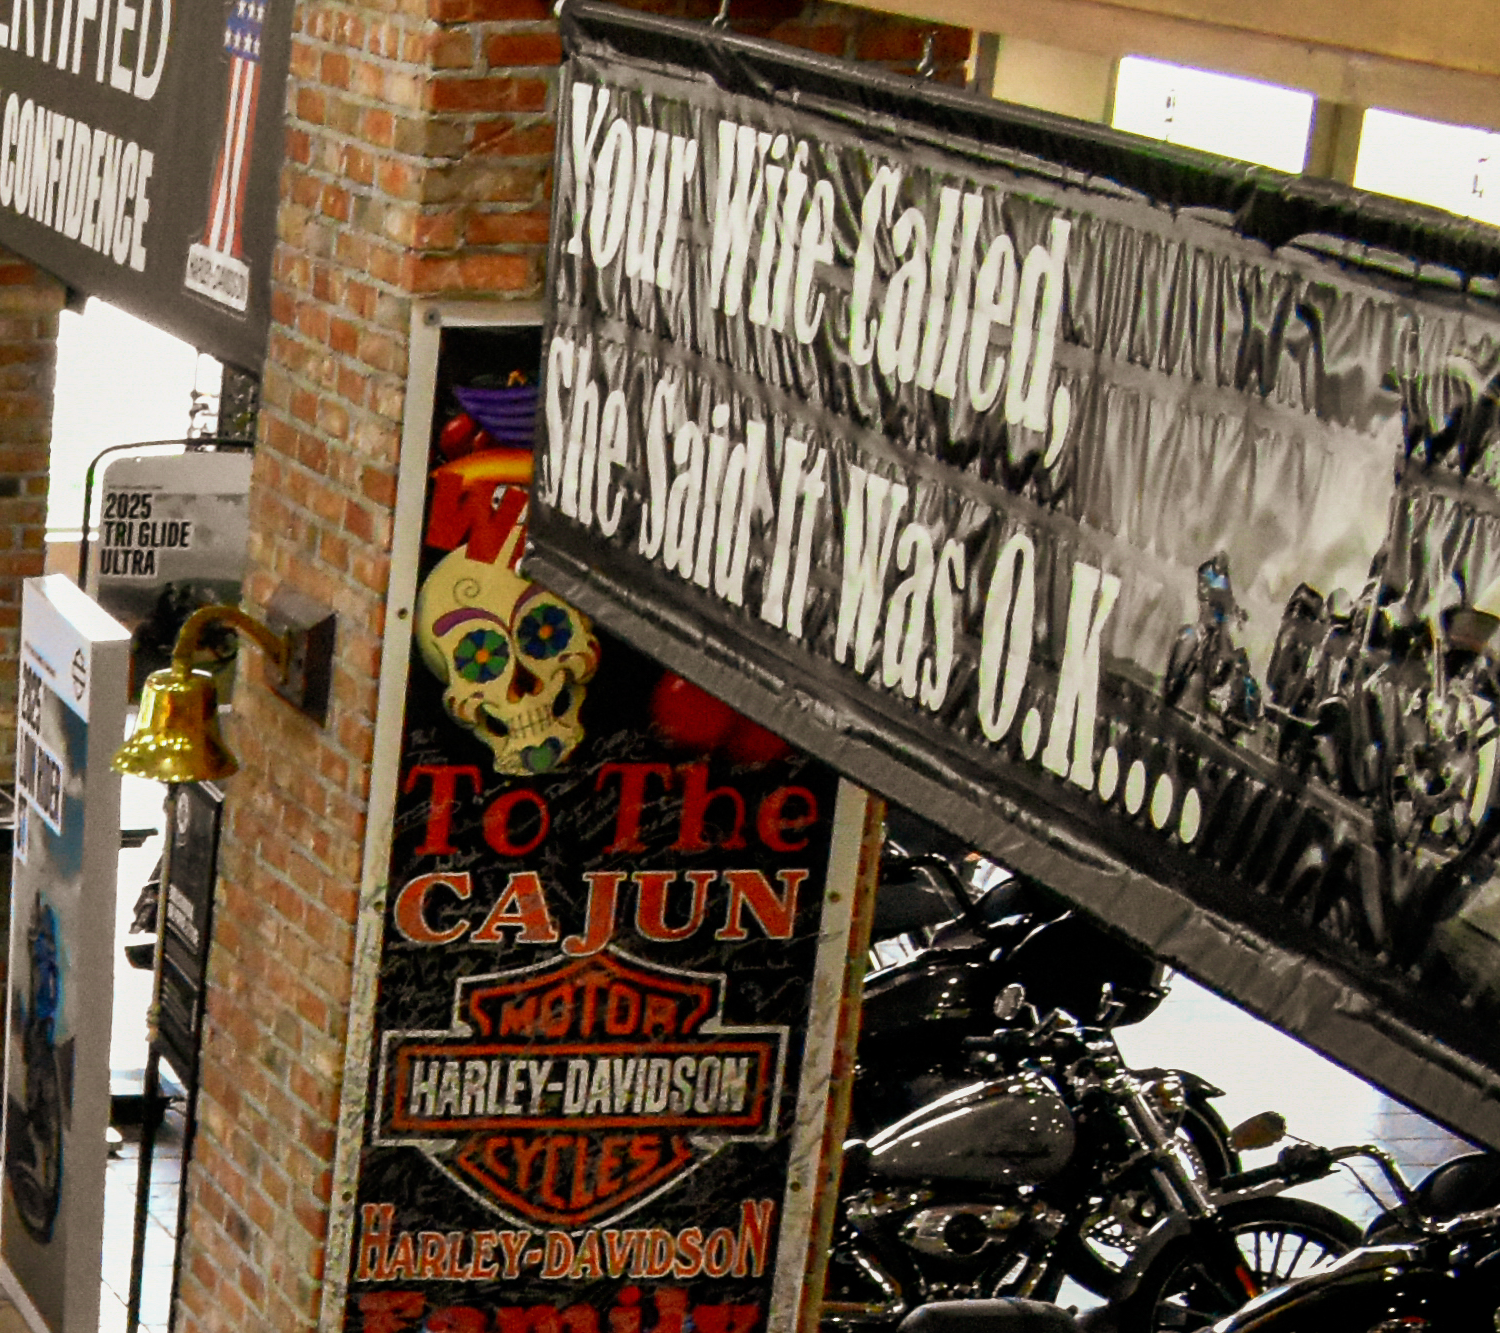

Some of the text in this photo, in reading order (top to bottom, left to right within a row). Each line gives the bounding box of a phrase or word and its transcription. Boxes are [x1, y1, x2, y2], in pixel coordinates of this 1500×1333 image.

[0, 92, 154, 272] CONFIDENCE
[568, 82, 1071, 469] Your Wife Called,
[103, 493, 153, 520] 2025
[103, 521, 192, 549] TRI GLIDE
[542, 336, 629, 538] She
[638, 368, 768, 606] Said
[761, 437, 826, 638] It
[834, 465, 964, 712] Was
[99, 549, 156, 576] ULTRA
[404, 761, 819, 857] To The
[393, 868, 810, 958] CAJUN
[499, 975, 680, 1038] MOTOR
[409, 1056, 751, 1117] HARLEY-DAVIDSON
[481, 1134, 664, 1211] CYCLES
[356, 1199, 775, 1282] HARLEY-DAVIDSON
